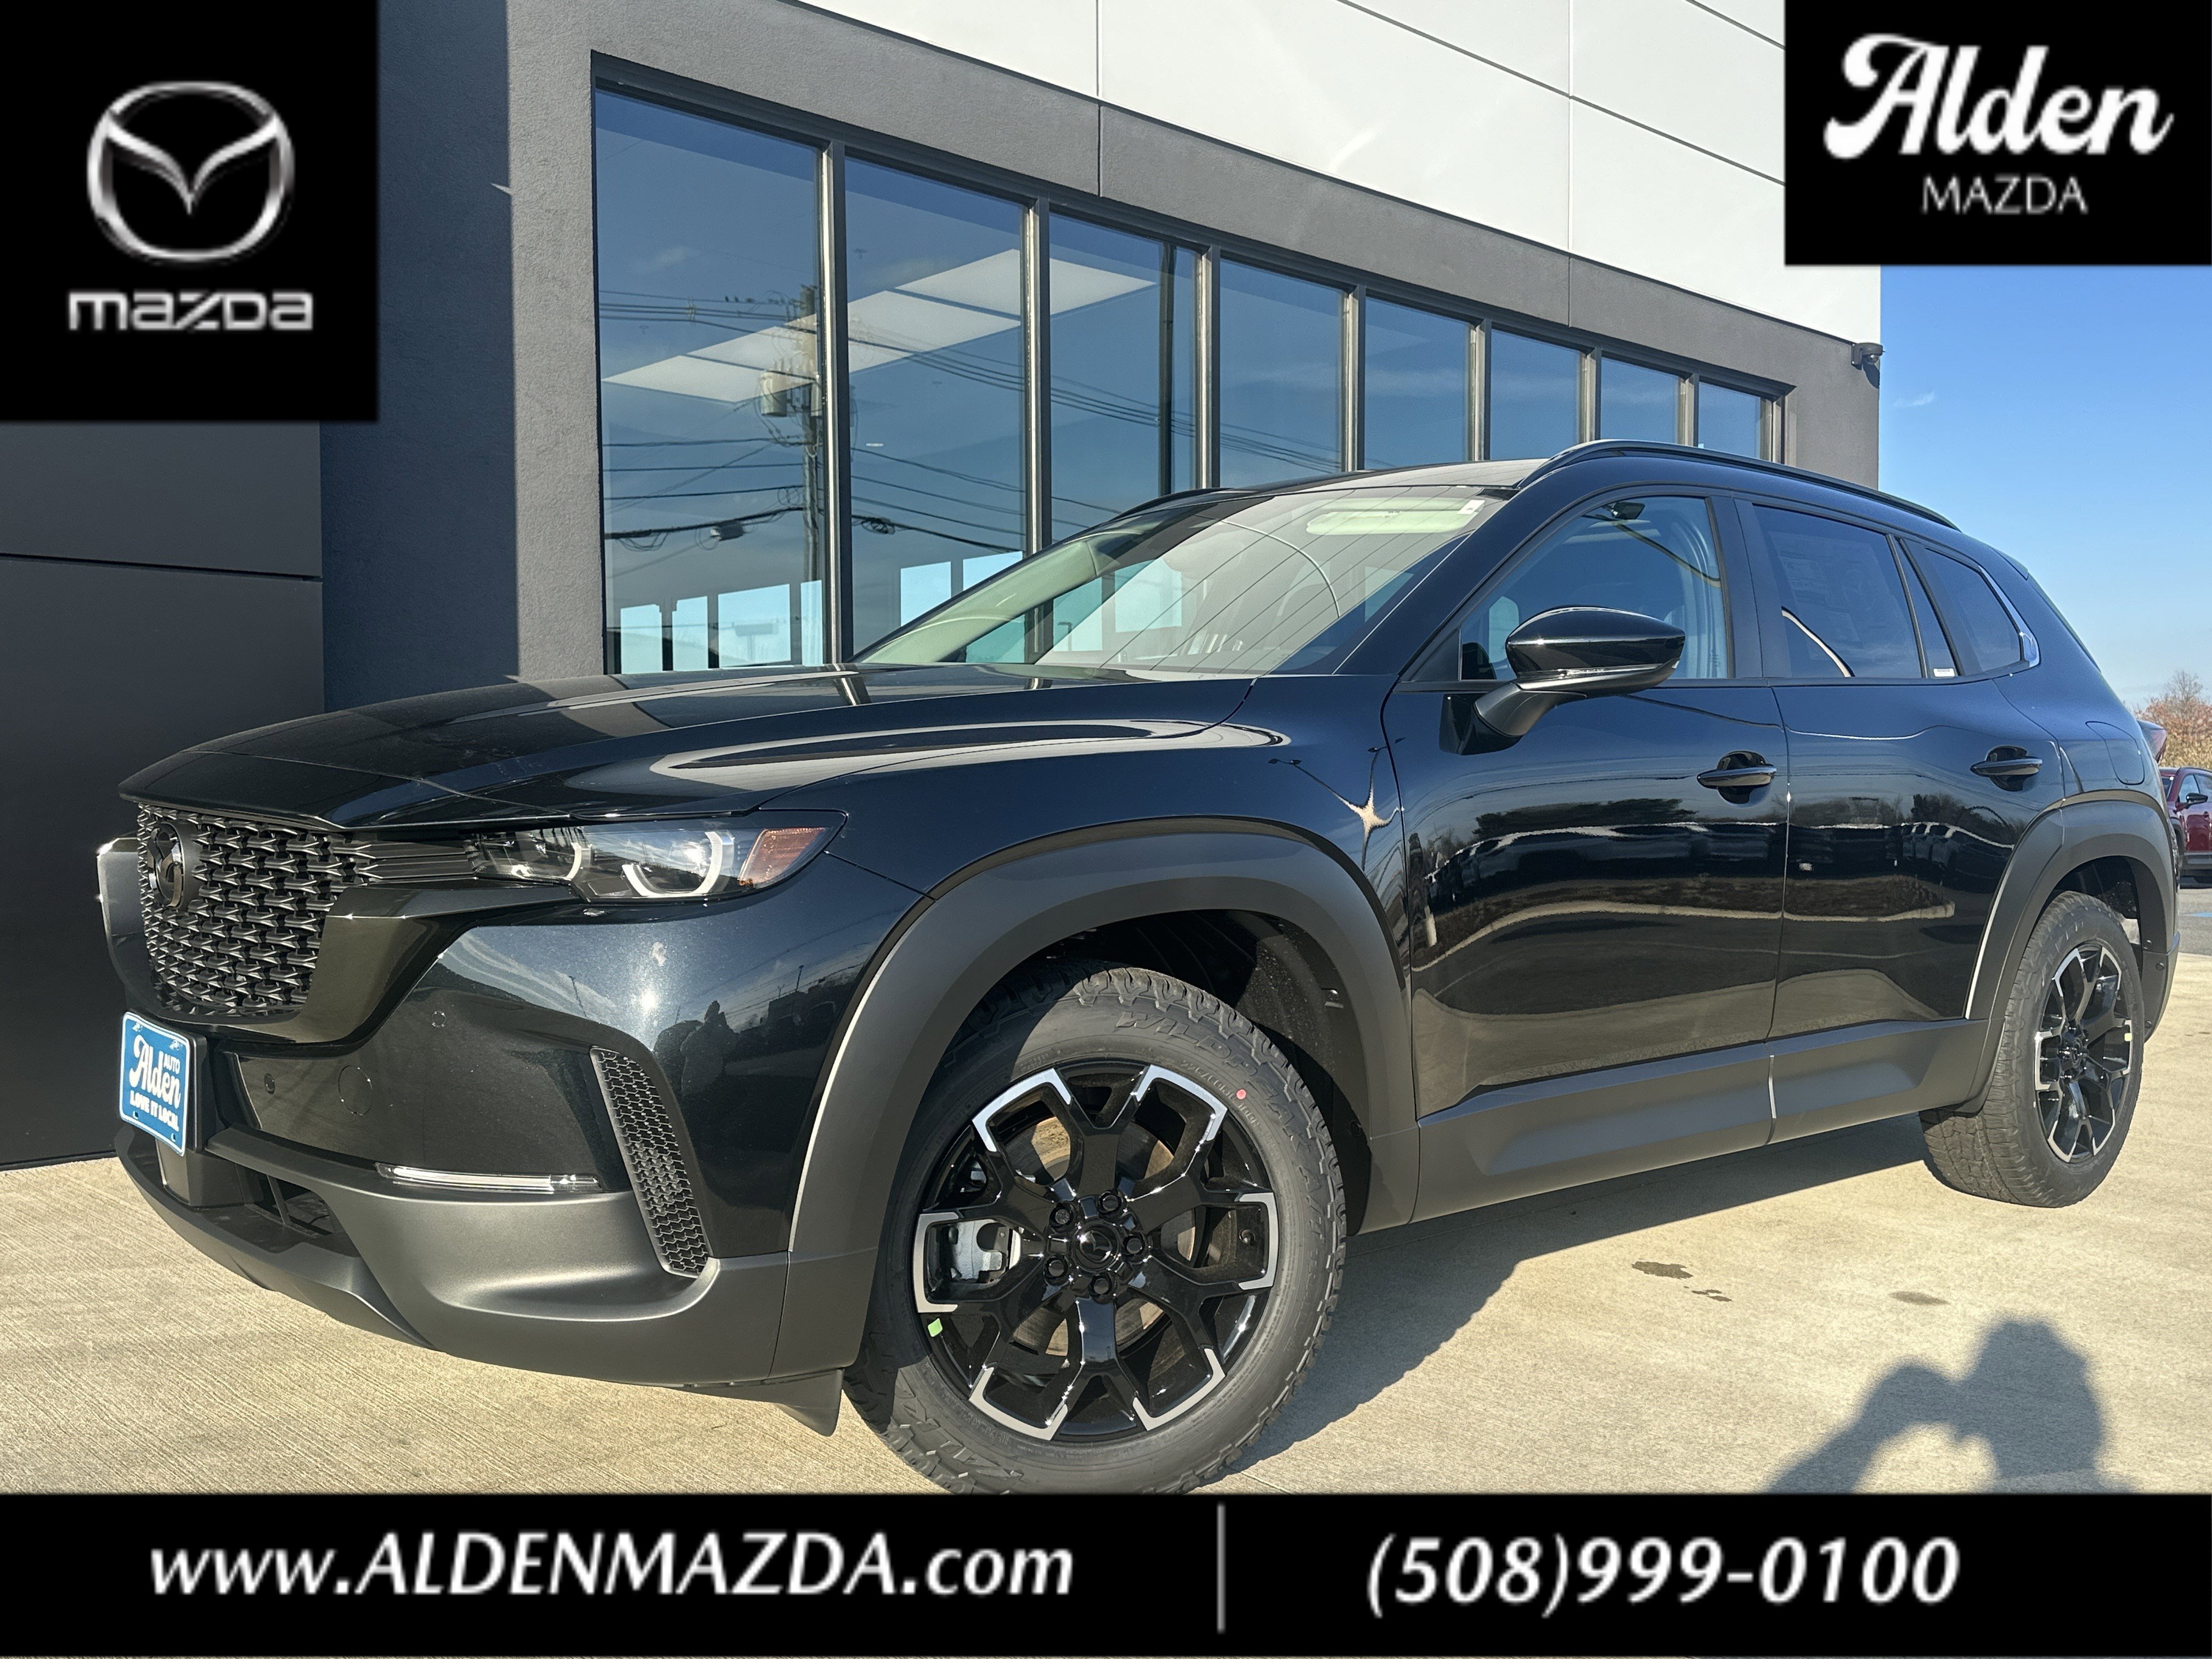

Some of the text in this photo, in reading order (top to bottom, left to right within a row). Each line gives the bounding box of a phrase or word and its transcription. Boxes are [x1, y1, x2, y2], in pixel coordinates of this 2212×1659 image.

[129, 1035, 181, 1108] Alden
[163, 1056, 180, 1074] AUTO
[1116, 1011, 1312, 1154] WILDPEAK
[130, 1090, 179, 1131] LOVE IT LOCAL
